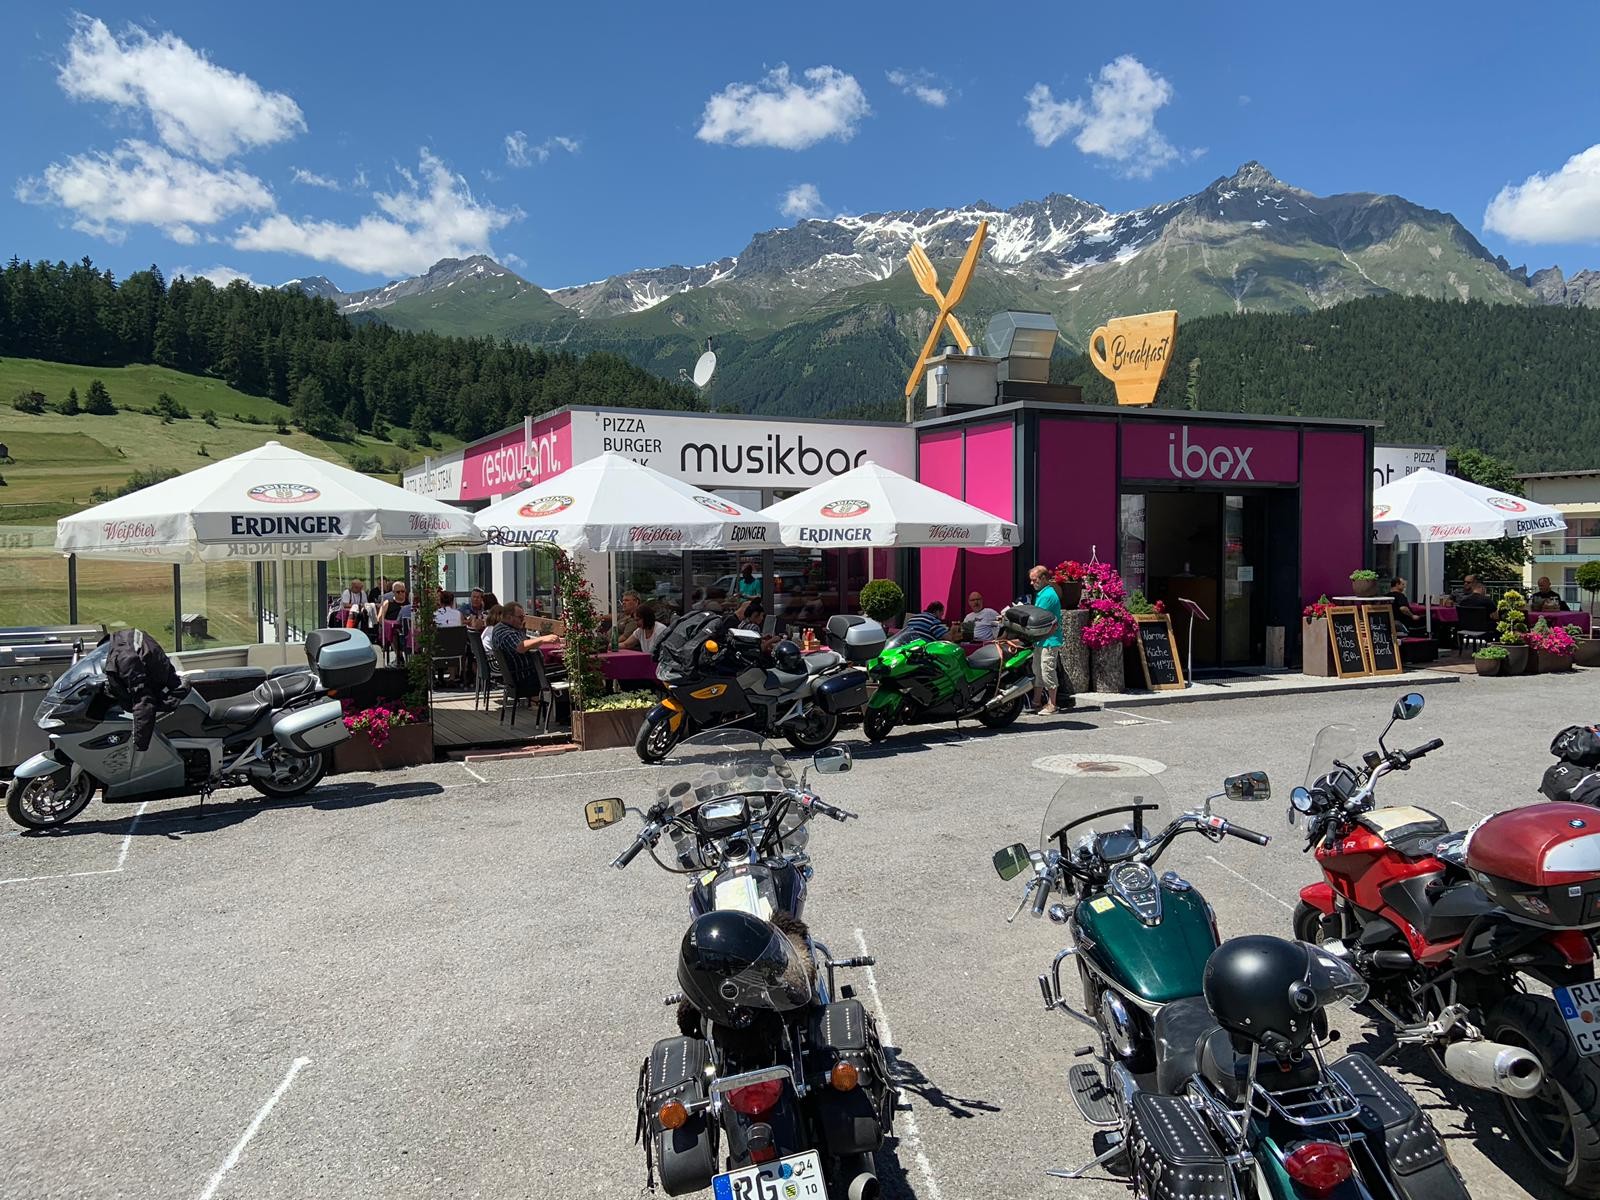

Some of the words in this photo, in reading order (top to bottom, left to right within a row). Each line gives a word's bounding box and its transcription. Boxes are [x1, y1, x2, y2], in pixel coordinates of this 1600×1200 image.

[1111, 335, 1170, 370] Breakfast
[603, 418, 646, 433] PIZZA
[603, 438, 662, 453] BURGER
[680, 434, 867, 476] musikbar
[1414, 452, 1435, 463] PIZZA
[437, 467, 453, 491] STEAK
[103, 520, 157, 543] Weißbier
[230, 515, 344, 537] ERDINGER
[409, 513, 452, 533] Weißbier
[1429, 524, 1472, 539] Weißbier
[1517, 517, 1557, 532] ERDINGER
[629, 526, 683, 544] Weißbier
[731, 525, 767, 542] ERDINGER
[800, 527, 872, 543] ERDINGER
[928, 524, 970, 541] Weißbier
[805, 1183, 818, 1196] 10
